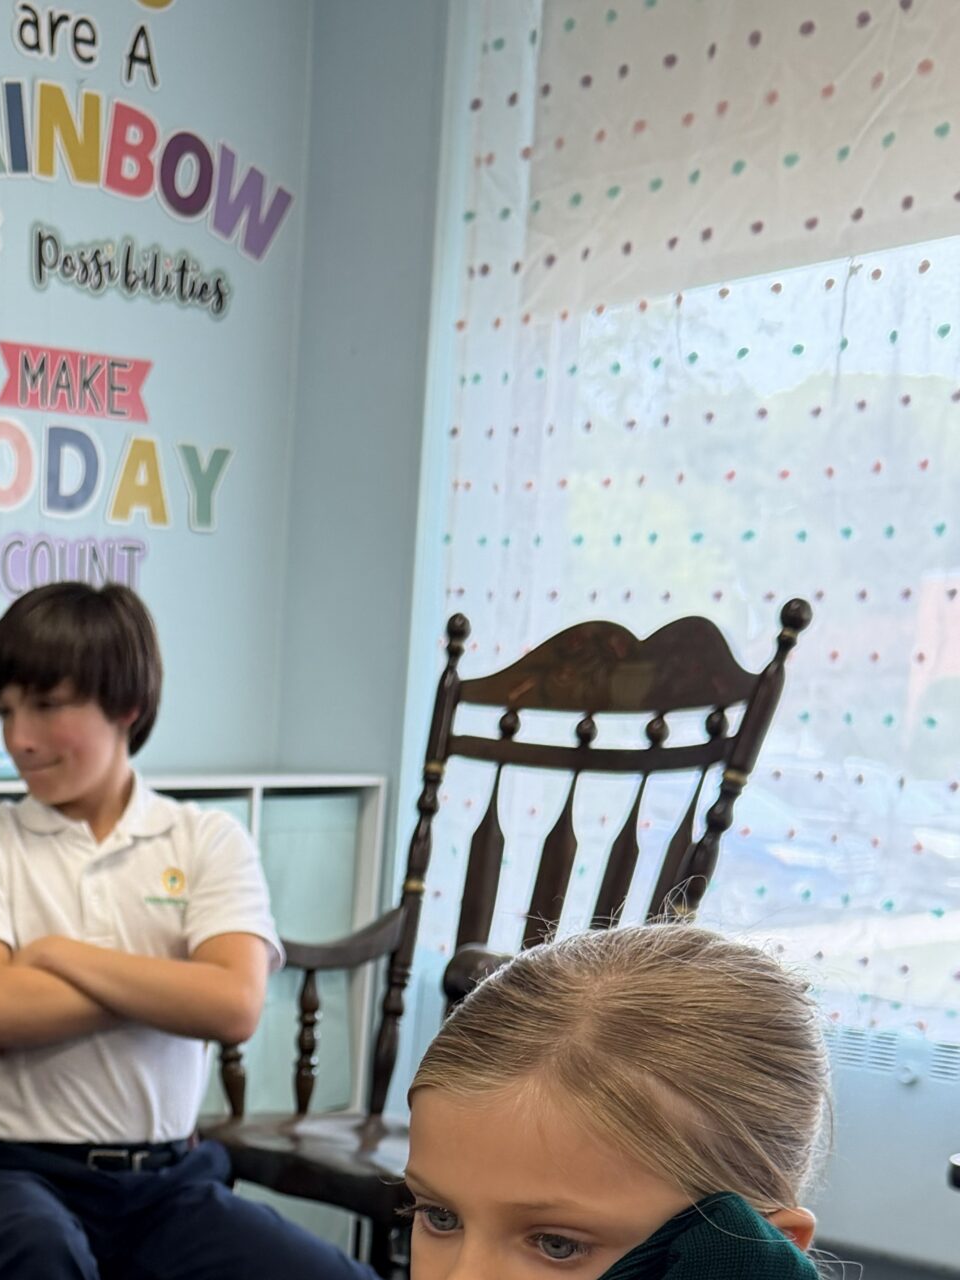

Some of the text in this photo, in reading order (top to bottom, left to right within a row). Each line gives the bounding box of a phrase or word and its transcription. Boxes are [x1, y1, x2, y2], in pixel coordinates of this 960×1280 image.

[18, 4, 157, 86] are A
[18, 351, 134, 418] MAKE
